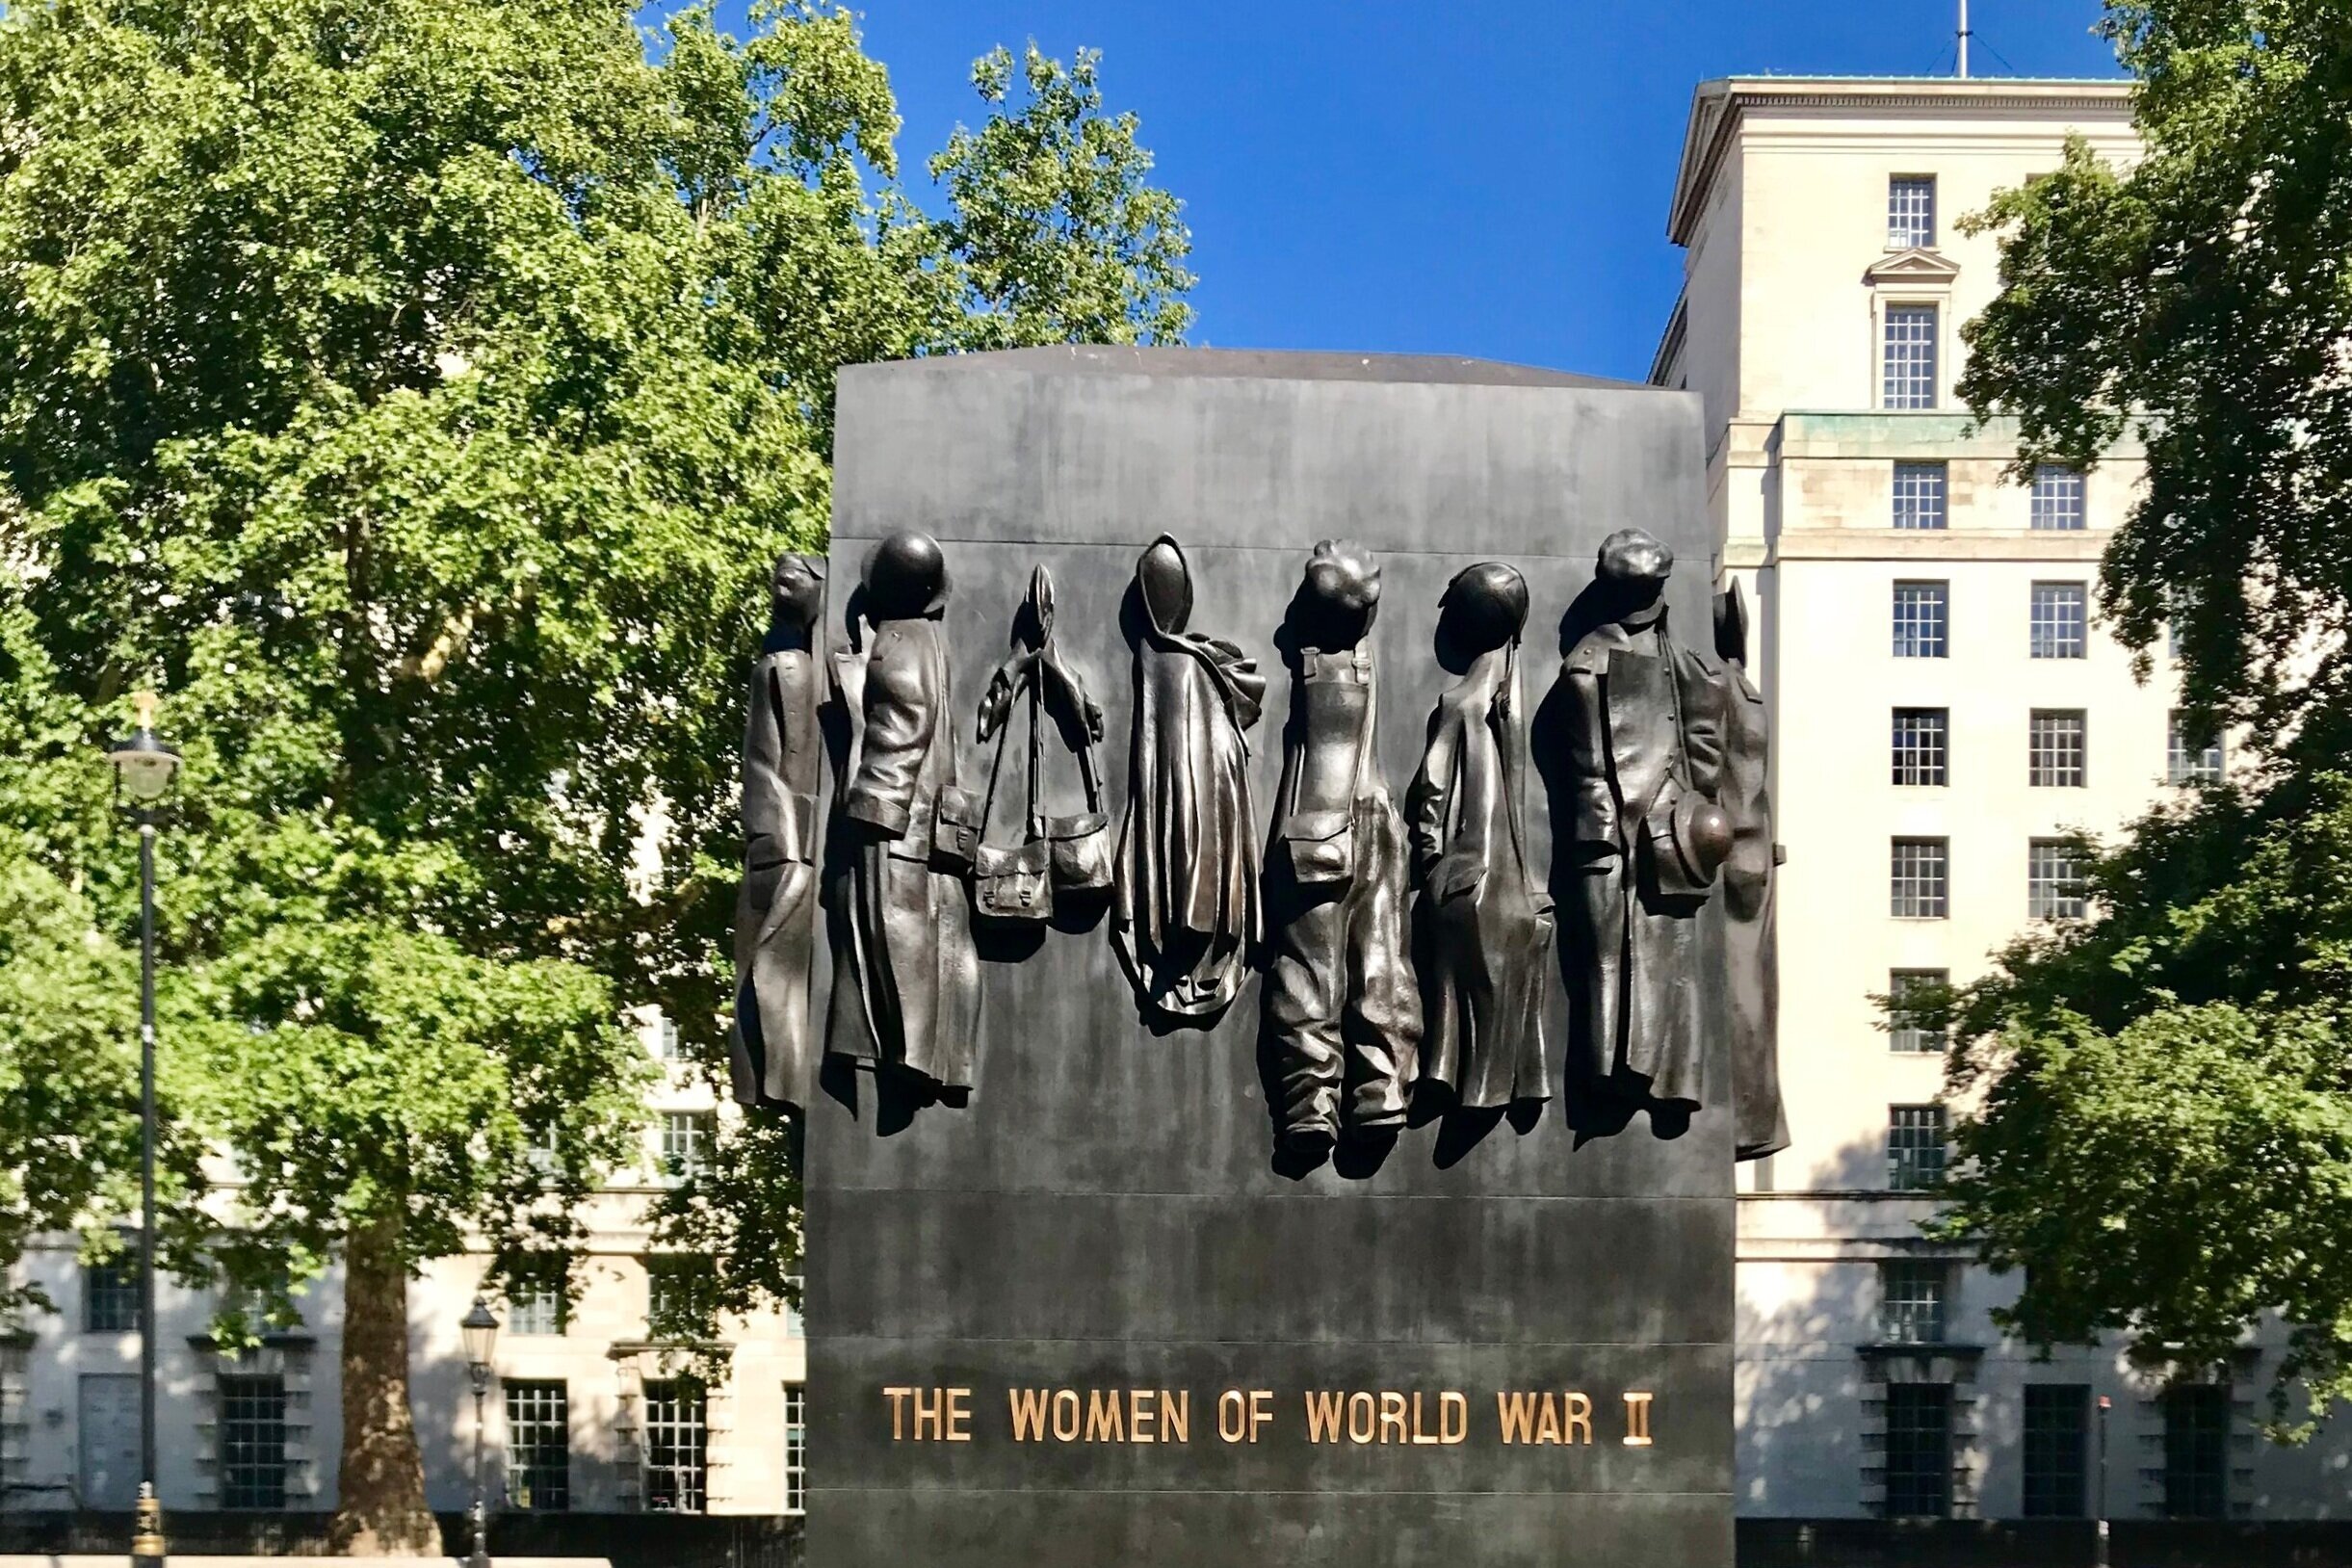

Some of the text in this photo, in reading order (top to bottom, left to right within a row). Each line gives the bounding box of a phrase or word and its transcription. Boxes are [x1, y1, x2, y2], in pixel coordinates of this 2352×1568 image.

[883, 1387, 1655, 1446] THE WOMEN OF WORLD WAR II
